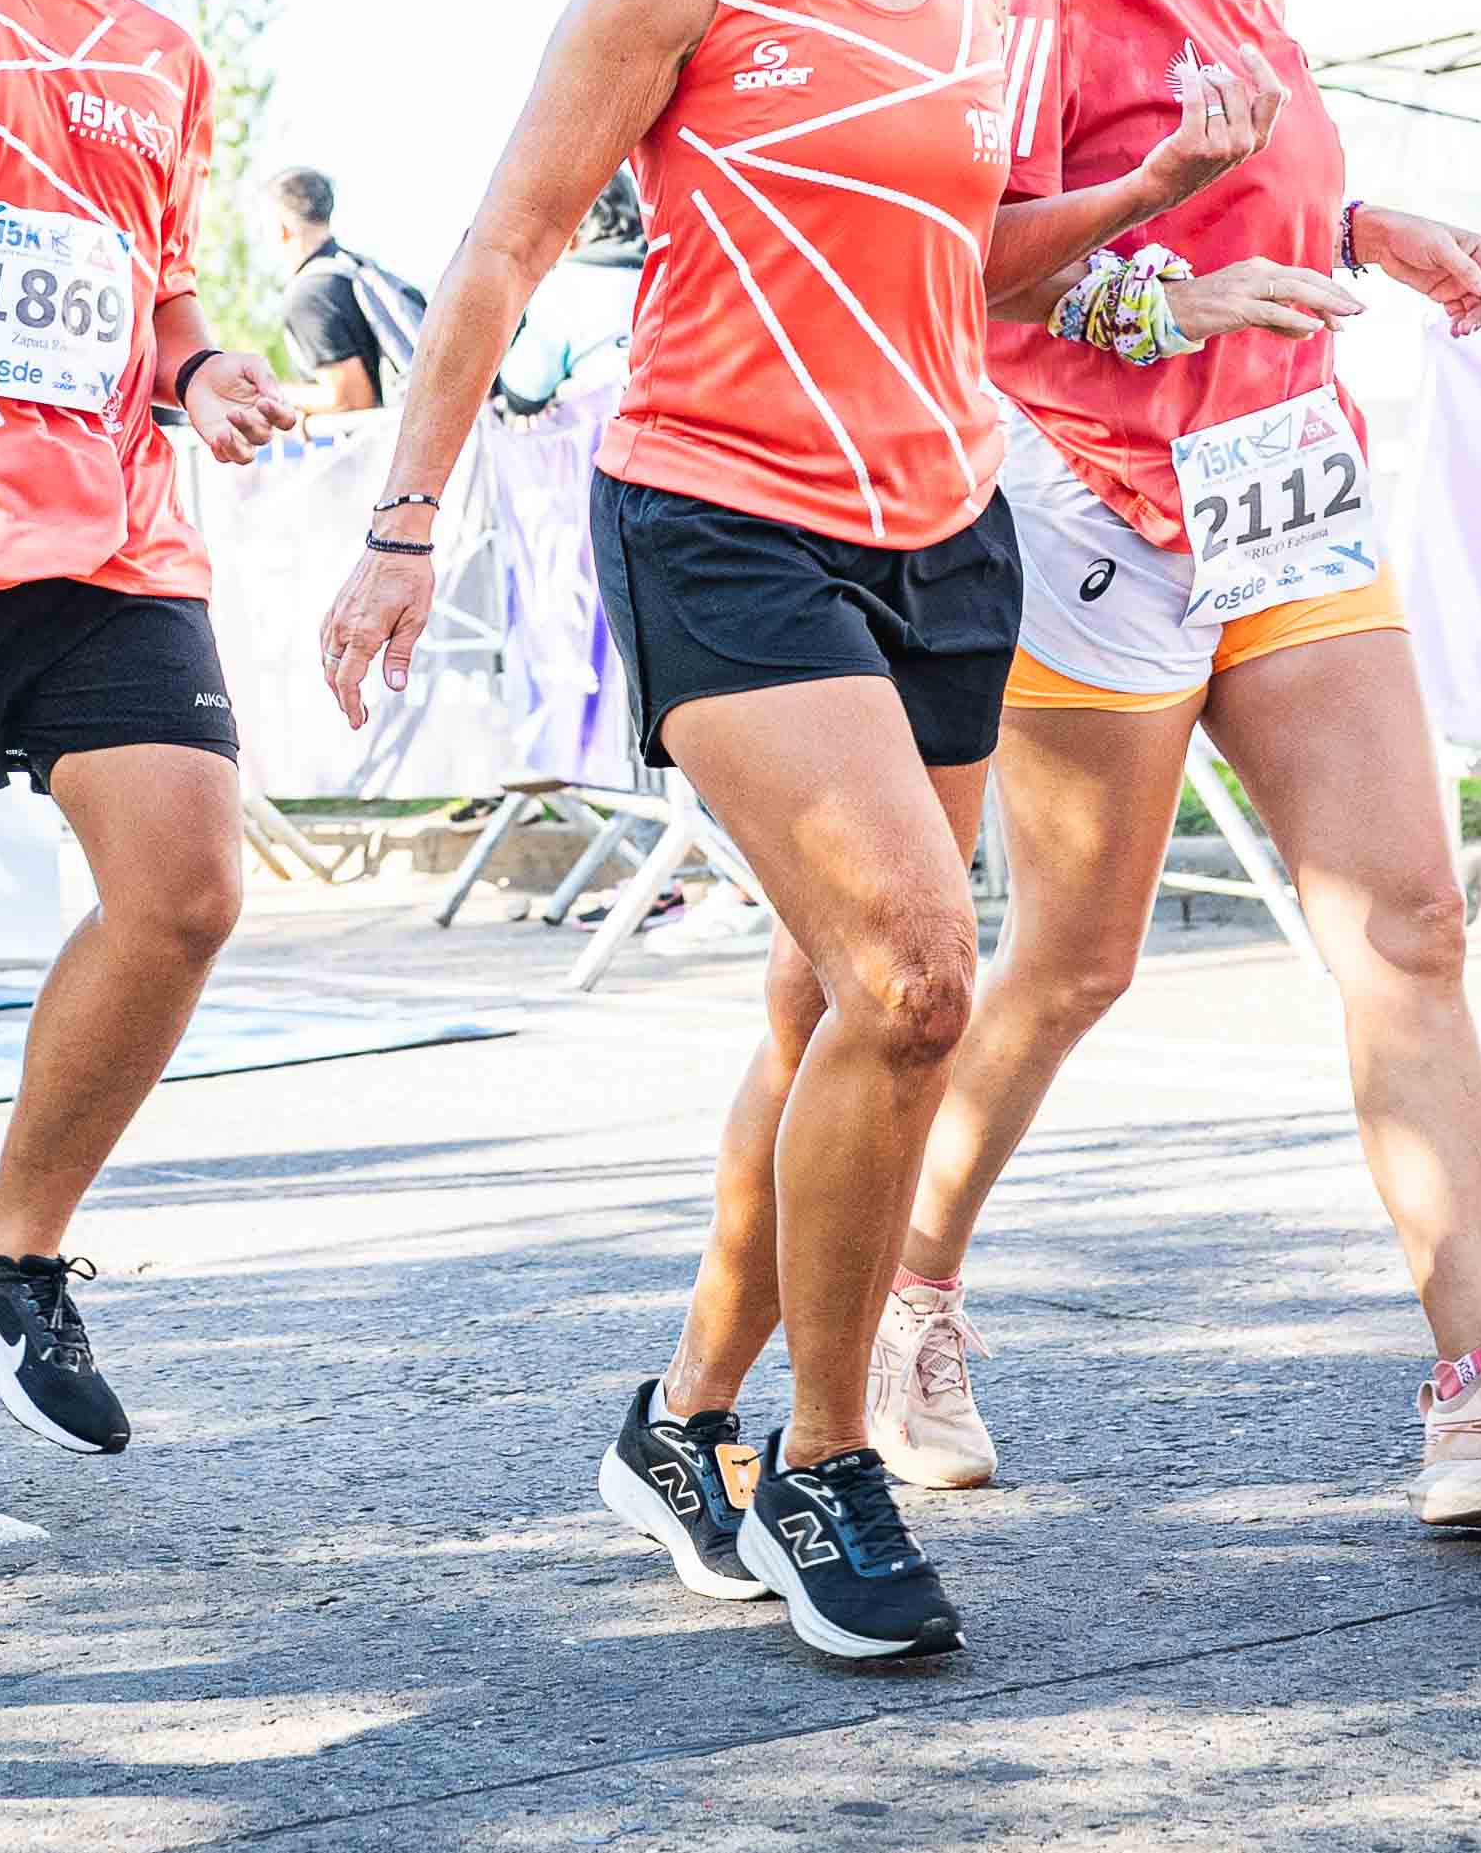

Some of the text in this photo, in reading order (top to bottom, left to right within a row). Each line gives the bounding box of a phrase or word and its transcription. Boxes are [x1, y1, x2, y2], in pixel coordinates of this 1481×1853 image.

[67, 91, 129, 136] 15K
[1196, 436, 1248, 479] 15K
[1193, 452, 1362, 563] 2112
[1214, 575, 1267, 610] osde
